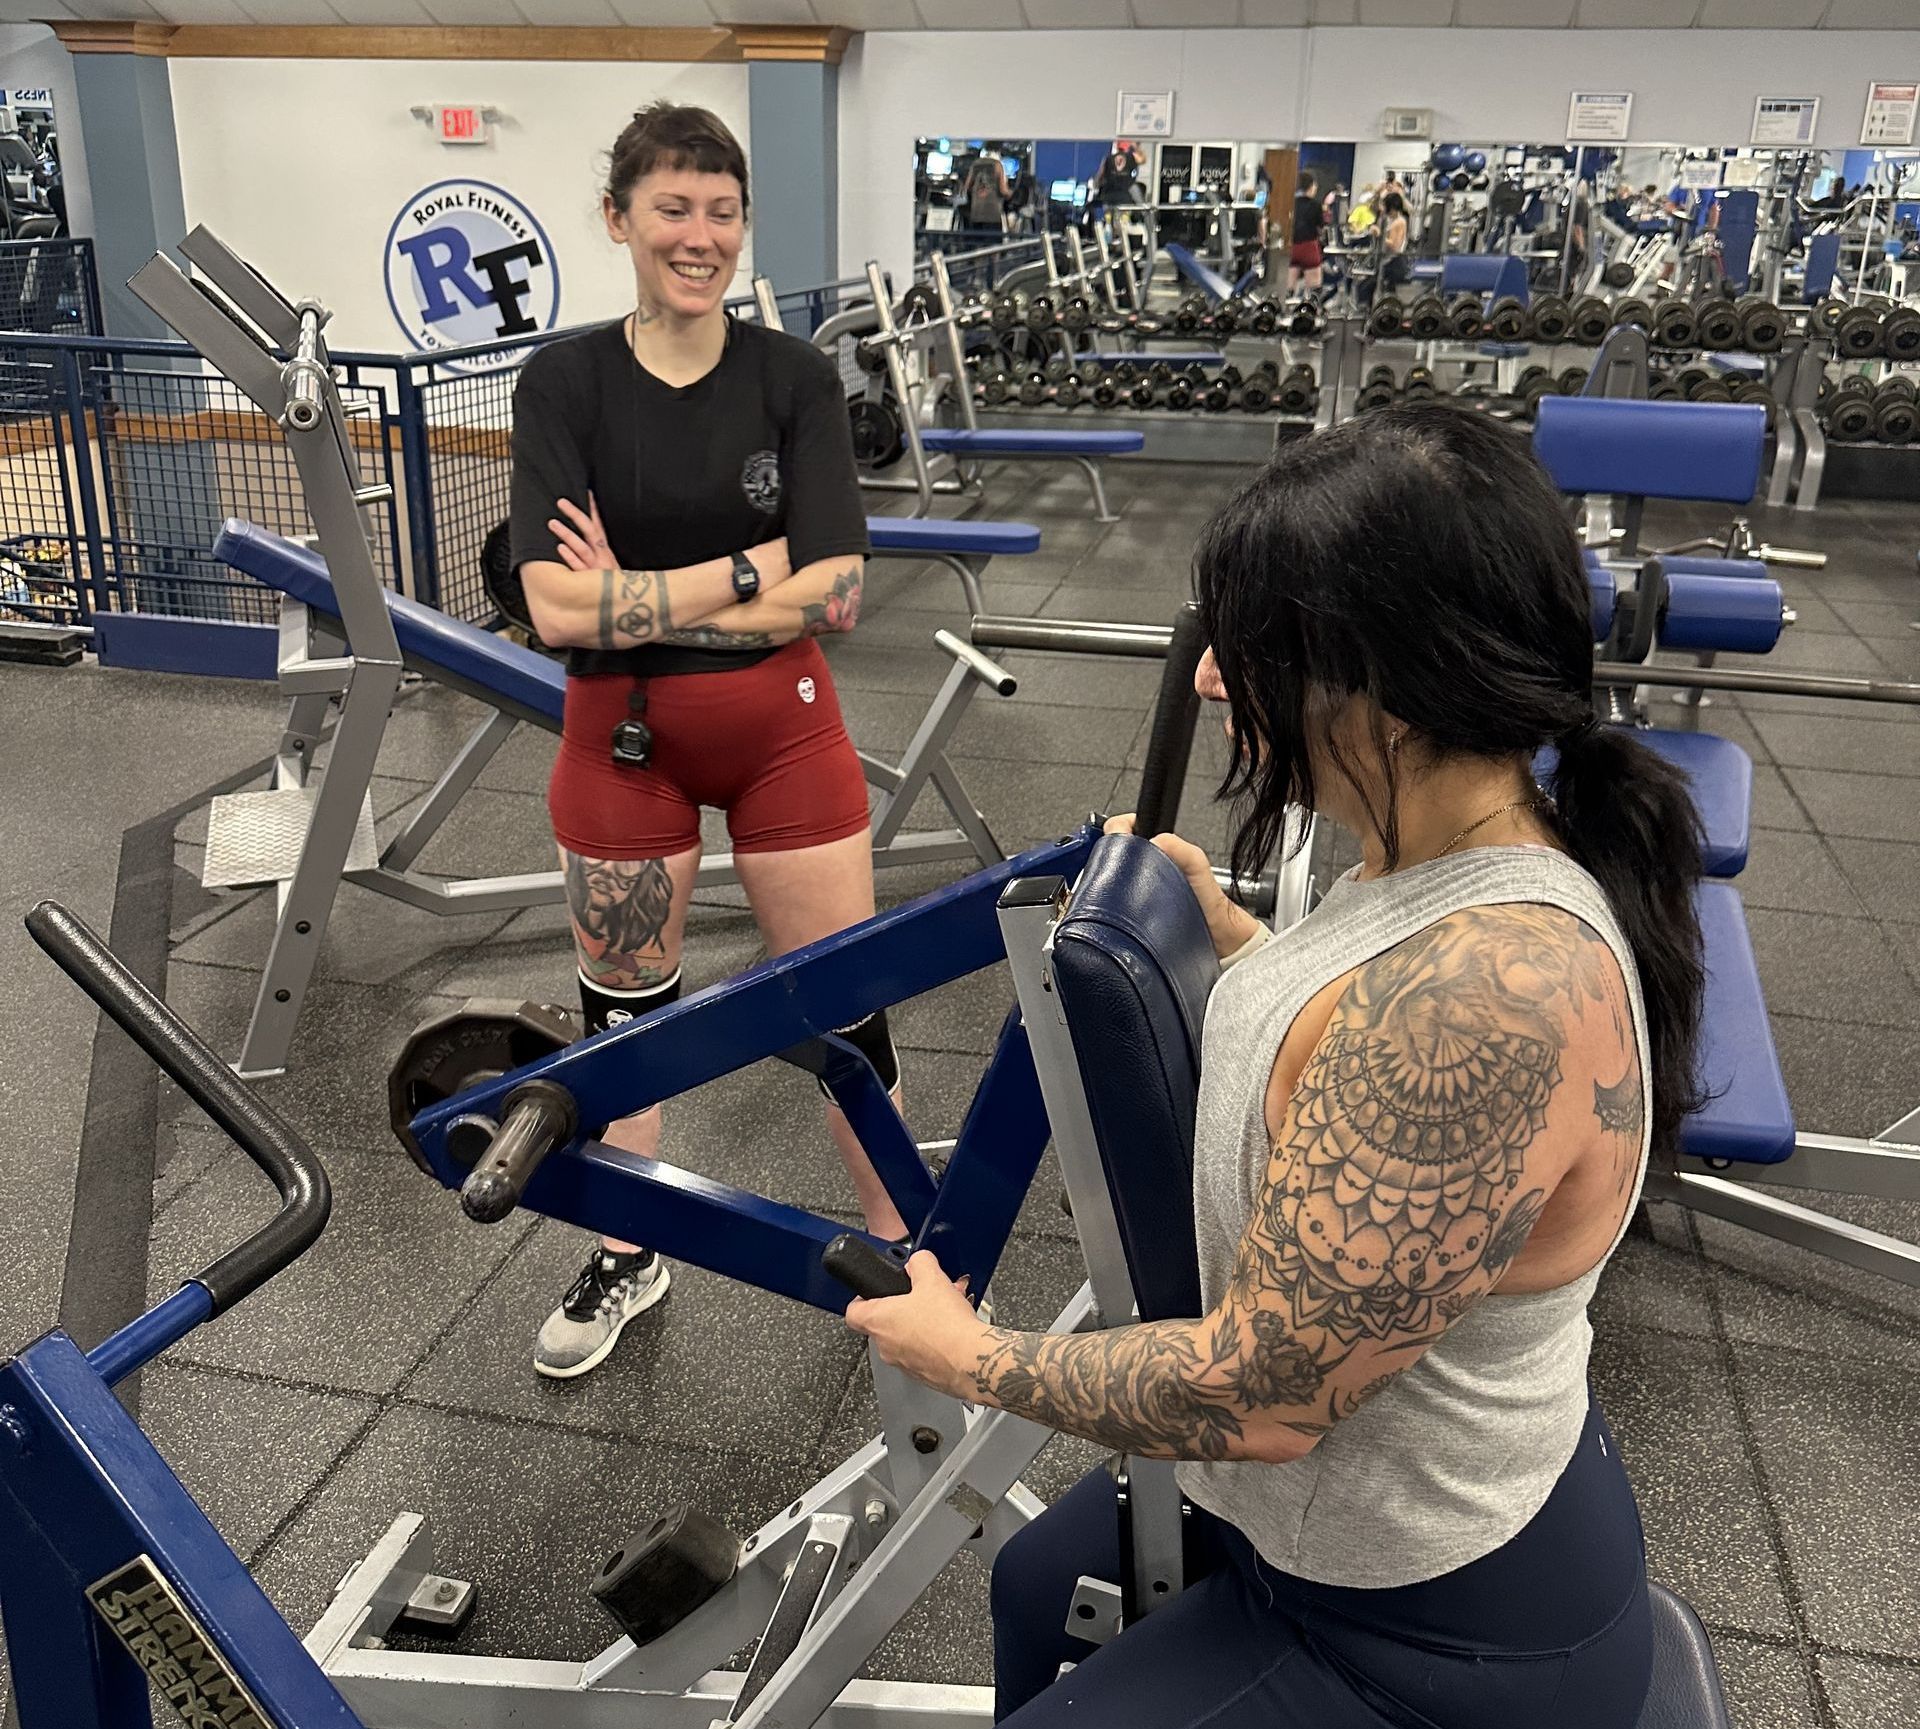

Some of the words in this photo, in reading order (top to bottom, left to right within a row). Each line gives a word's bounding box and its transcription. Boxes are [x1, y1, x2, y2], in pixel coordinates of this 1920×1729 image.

[442, 108, 474, 137] EXIT
[397, 226, 543, 338] RF
[126, 1580, 262, 1729] HAMM
